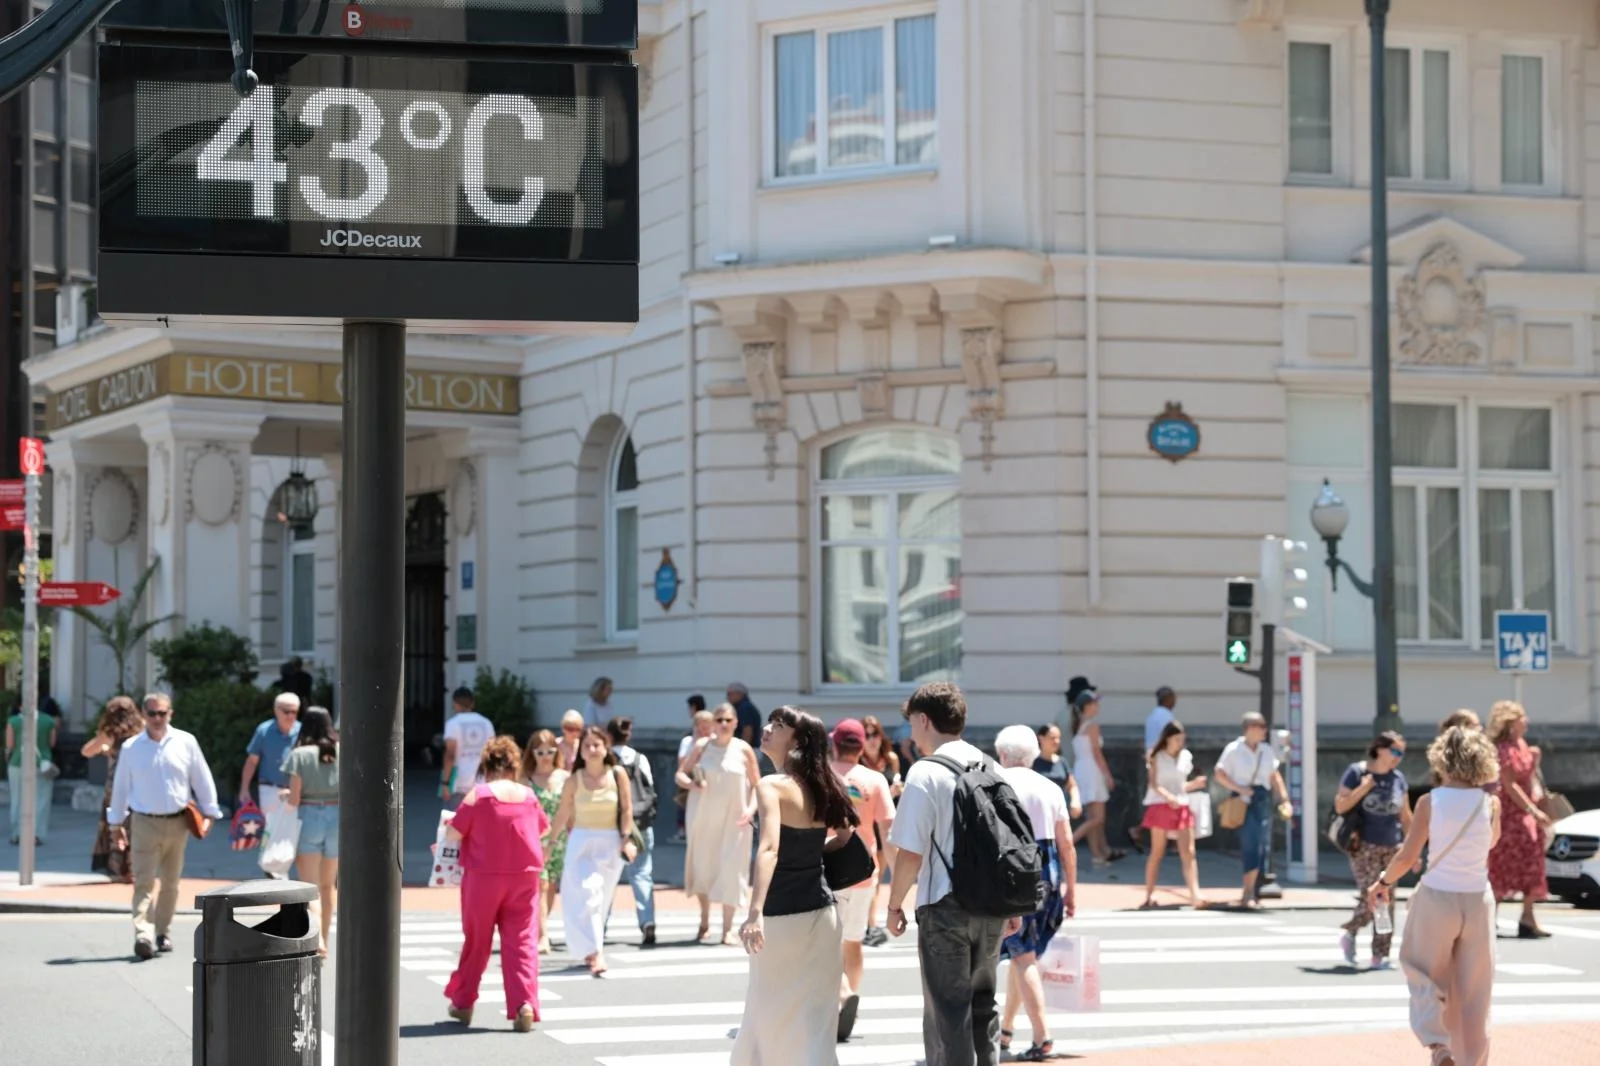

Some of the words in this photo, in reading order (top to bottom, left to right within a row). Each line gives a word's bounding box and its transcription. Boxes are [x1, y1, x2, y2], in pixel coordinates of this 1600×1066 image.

[197, 85, 544, 224] 43°C
[320, 229, 422, 248] JCDecaux
[57, 386, 91, 425] HOTEL
[98, 360, 156, 411] CARLTON
[185, 358, 304, 398] HOTEL
[335, 372, 504, 409] RLTON
[1500, 632, 1546, 652] TAXI
